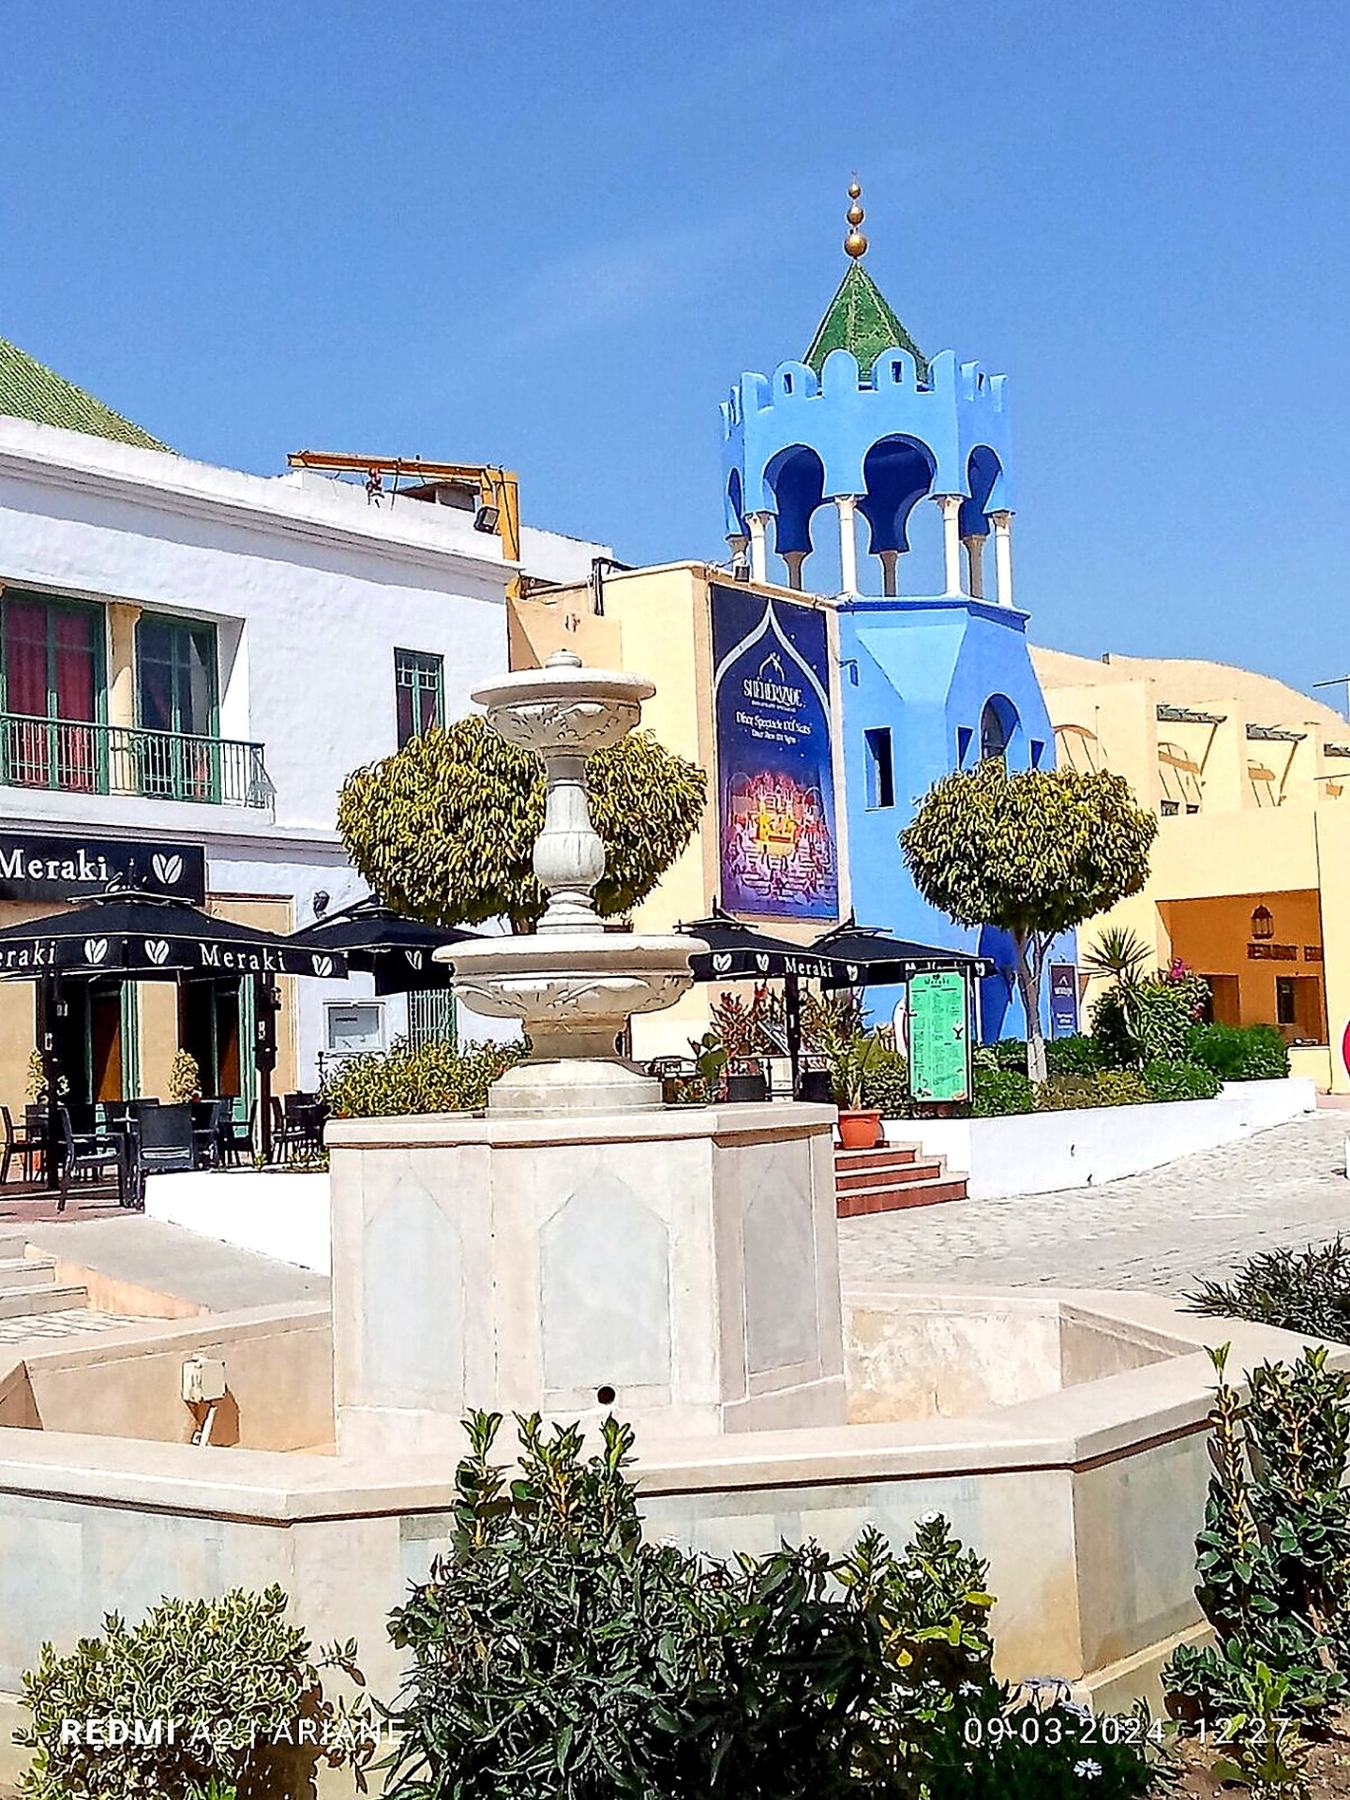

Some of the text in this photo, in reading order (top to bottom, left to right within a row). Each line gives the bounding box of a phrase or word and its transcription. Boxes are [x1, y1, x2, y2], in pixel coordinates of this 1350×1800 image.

[0, 848, 109, 881] Meraki
[198, 943, 287, 971] Meraki
[784, 957, 835, 978] Meraki
